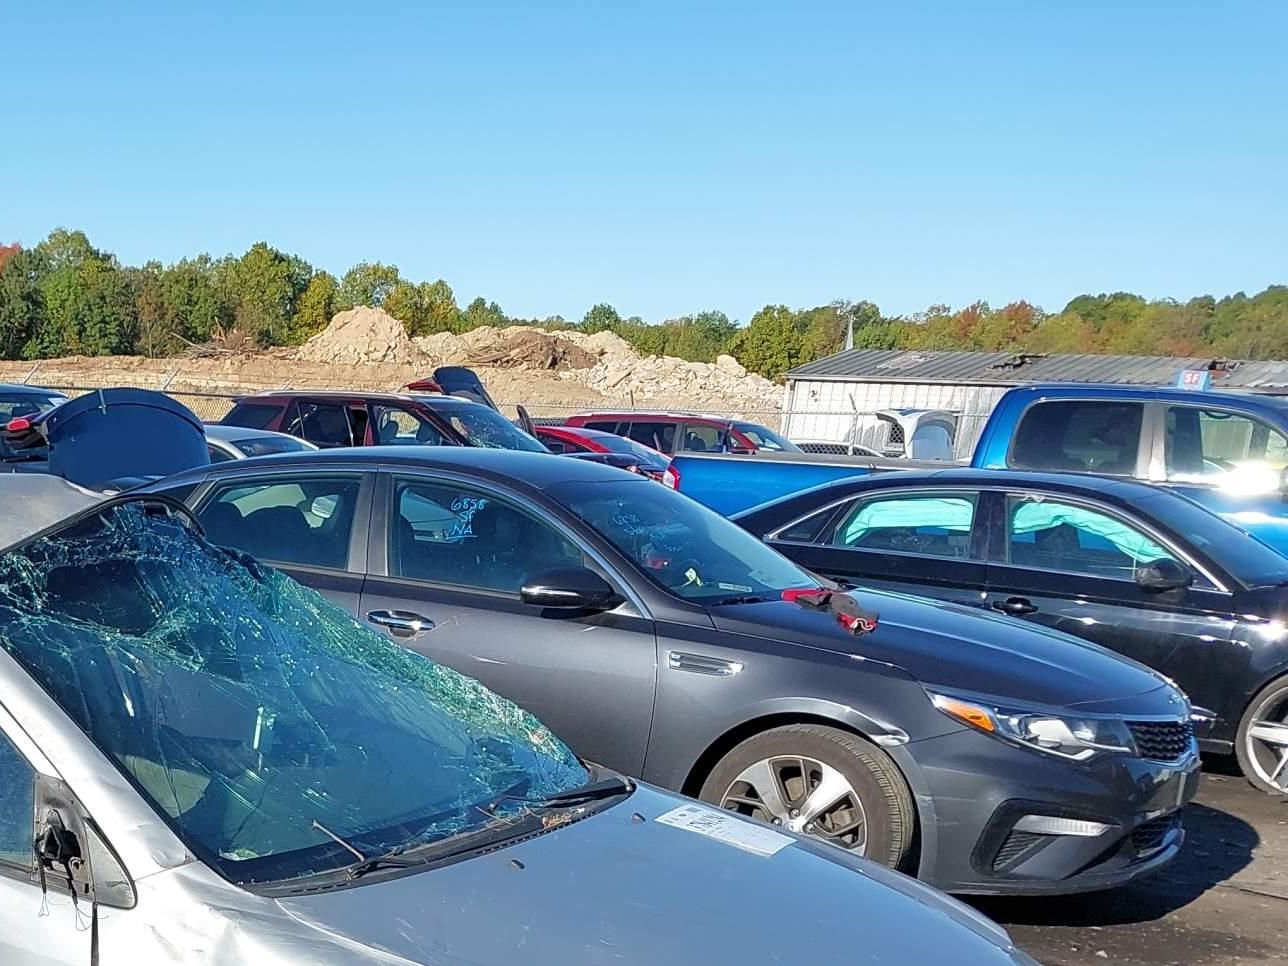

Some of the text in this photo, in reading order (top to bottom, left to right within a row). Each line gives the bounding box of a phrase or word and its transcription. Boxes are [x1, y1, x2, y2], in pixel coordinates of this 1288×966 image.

[1184, 373, 1200, 384] SF
[450, 497, 489, 511] 6858
[451, 523, 473, 535] NA
